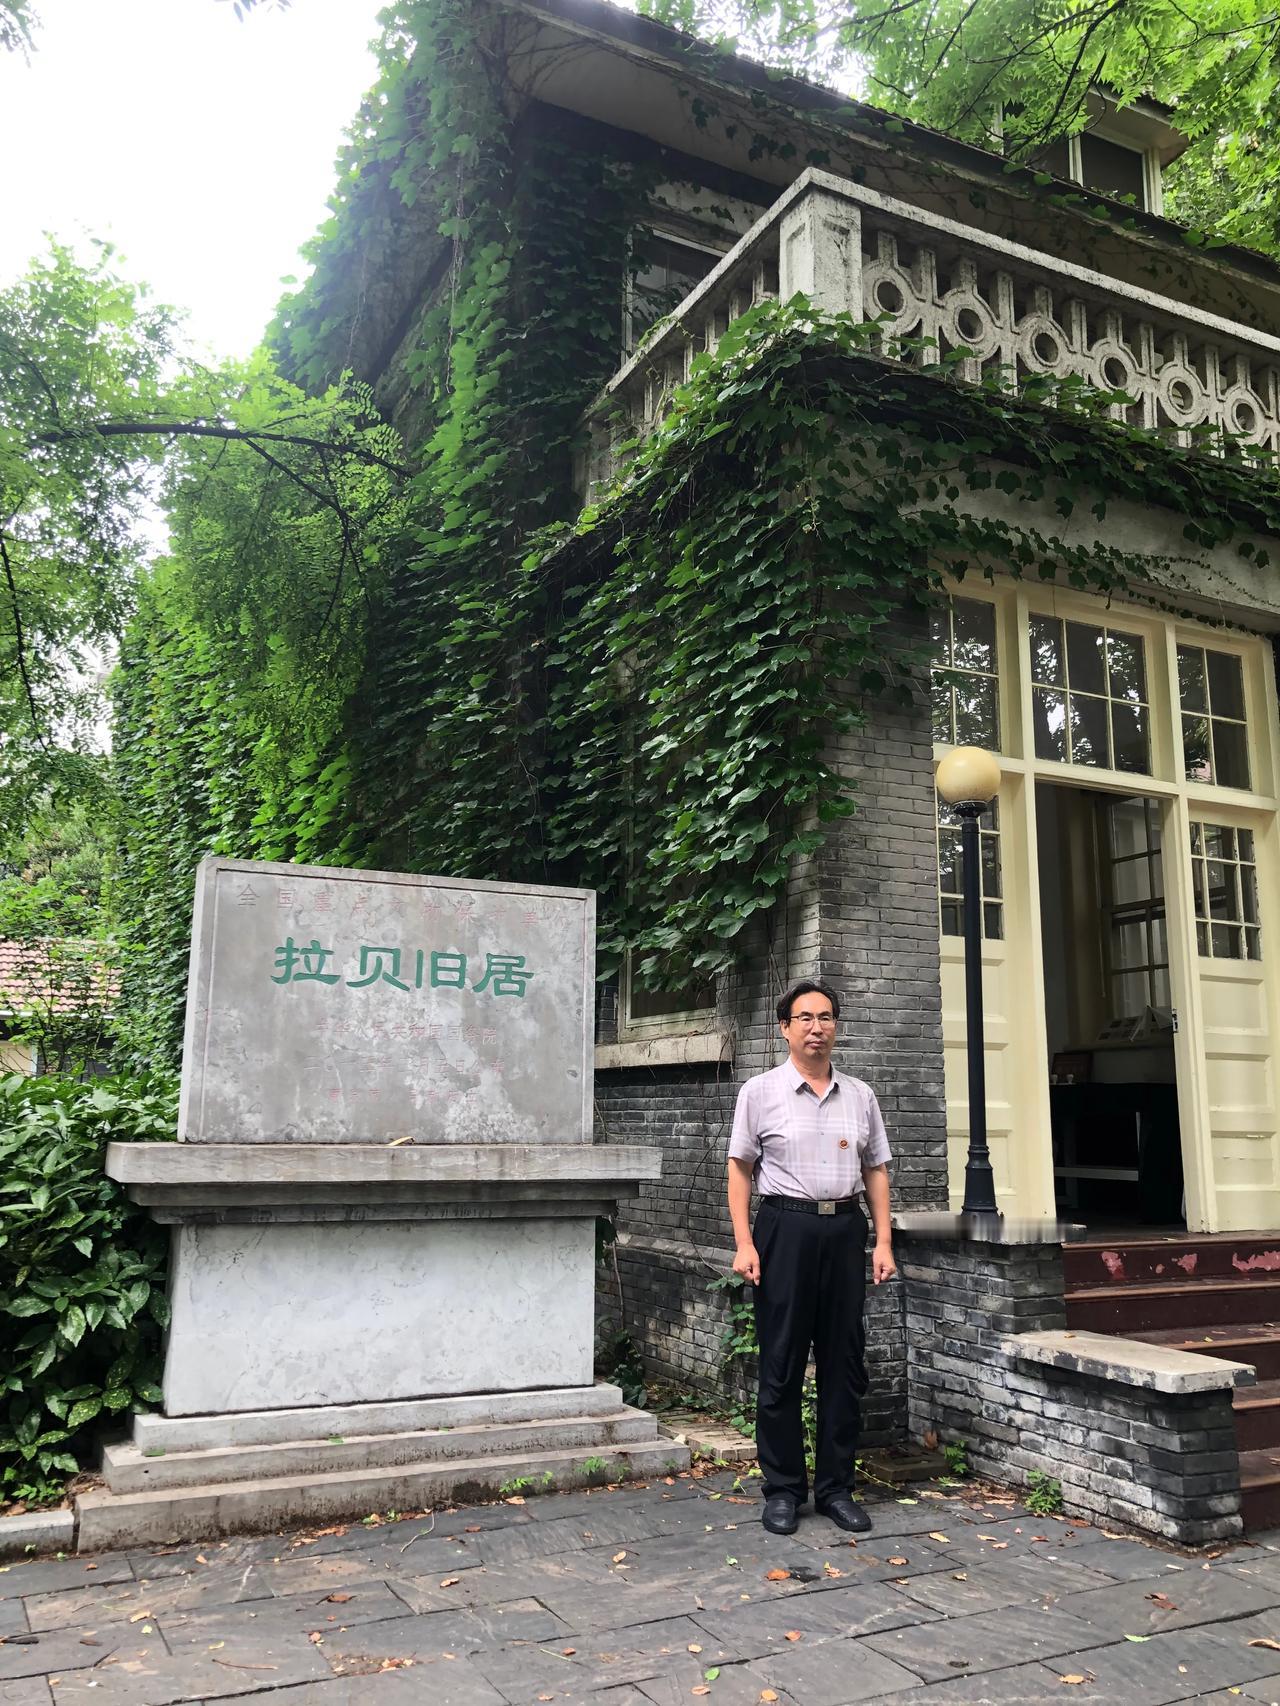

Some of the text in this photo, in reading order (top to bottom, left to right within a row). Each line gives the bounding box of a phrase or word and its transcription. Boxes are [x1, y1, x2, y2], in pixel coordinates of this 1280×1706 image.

[236, 883, 574, 931] 全国重点文物保单
[270, 937, 535, 998] 拉贝旧居
